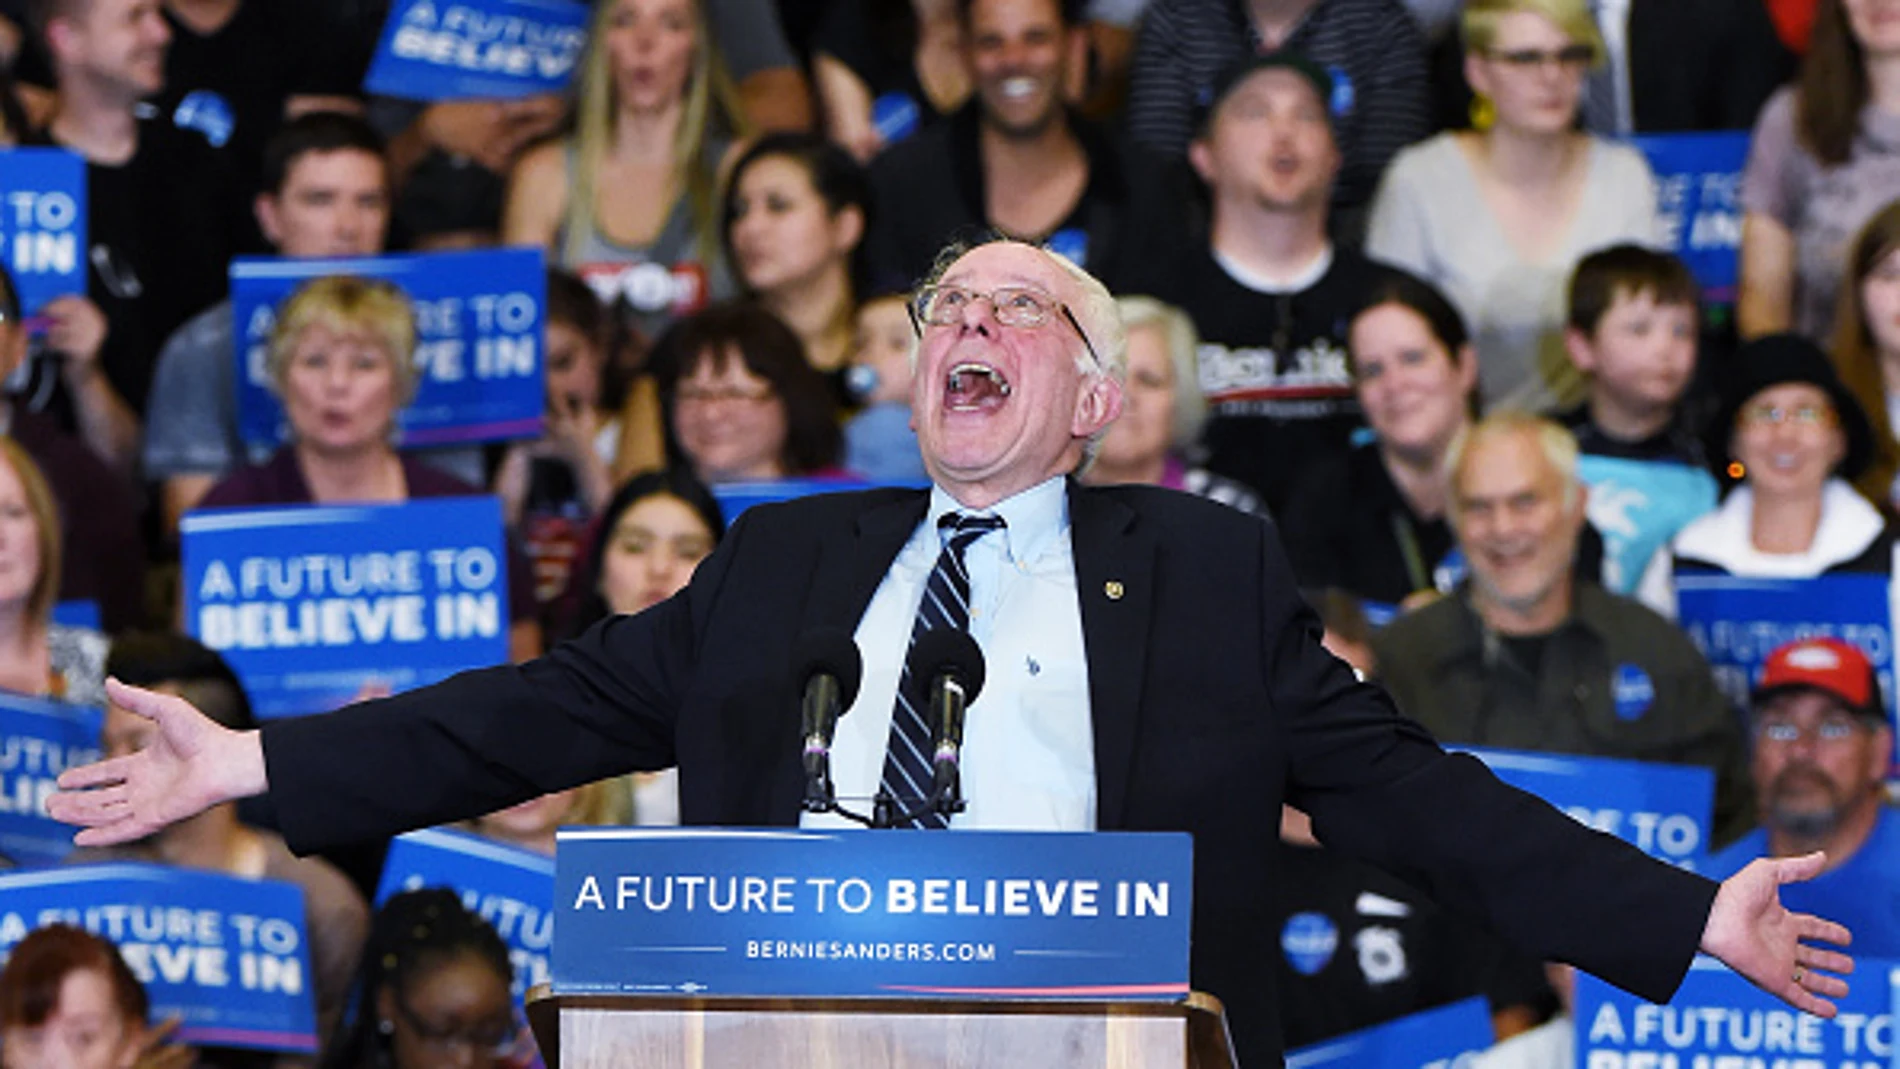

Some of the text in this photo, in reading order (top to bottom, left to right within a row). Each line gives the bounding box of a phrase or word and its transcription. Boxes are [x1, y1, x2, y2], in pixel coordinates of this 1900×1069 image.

[441, 5, 588, 49] FUTUR
[391, 26, 576, 79] BELIEV
[8, 191, 77, 231] TO
[14, 231, 77, 274] IN
[468, 291, 537, 333] TO
[474, 332, 536, 379] IN
[200, 547, 498, 600] A FUTURE TO
[200, 590, 499, 651] BELIEVE IN
[1629, 811, 1699, 857] TO
[575, 875, 1170, 917] A FUTURE TO BELIEVE IN
[228, 914, 300, 956] TO
[746, 939, 996, 962] BERNIESANDERS.COM
[238, 950, 304, 996] IN
[1589, 1002, 1627, 1045] A
[1633, 1003, 1825, 1054] FUTURE
